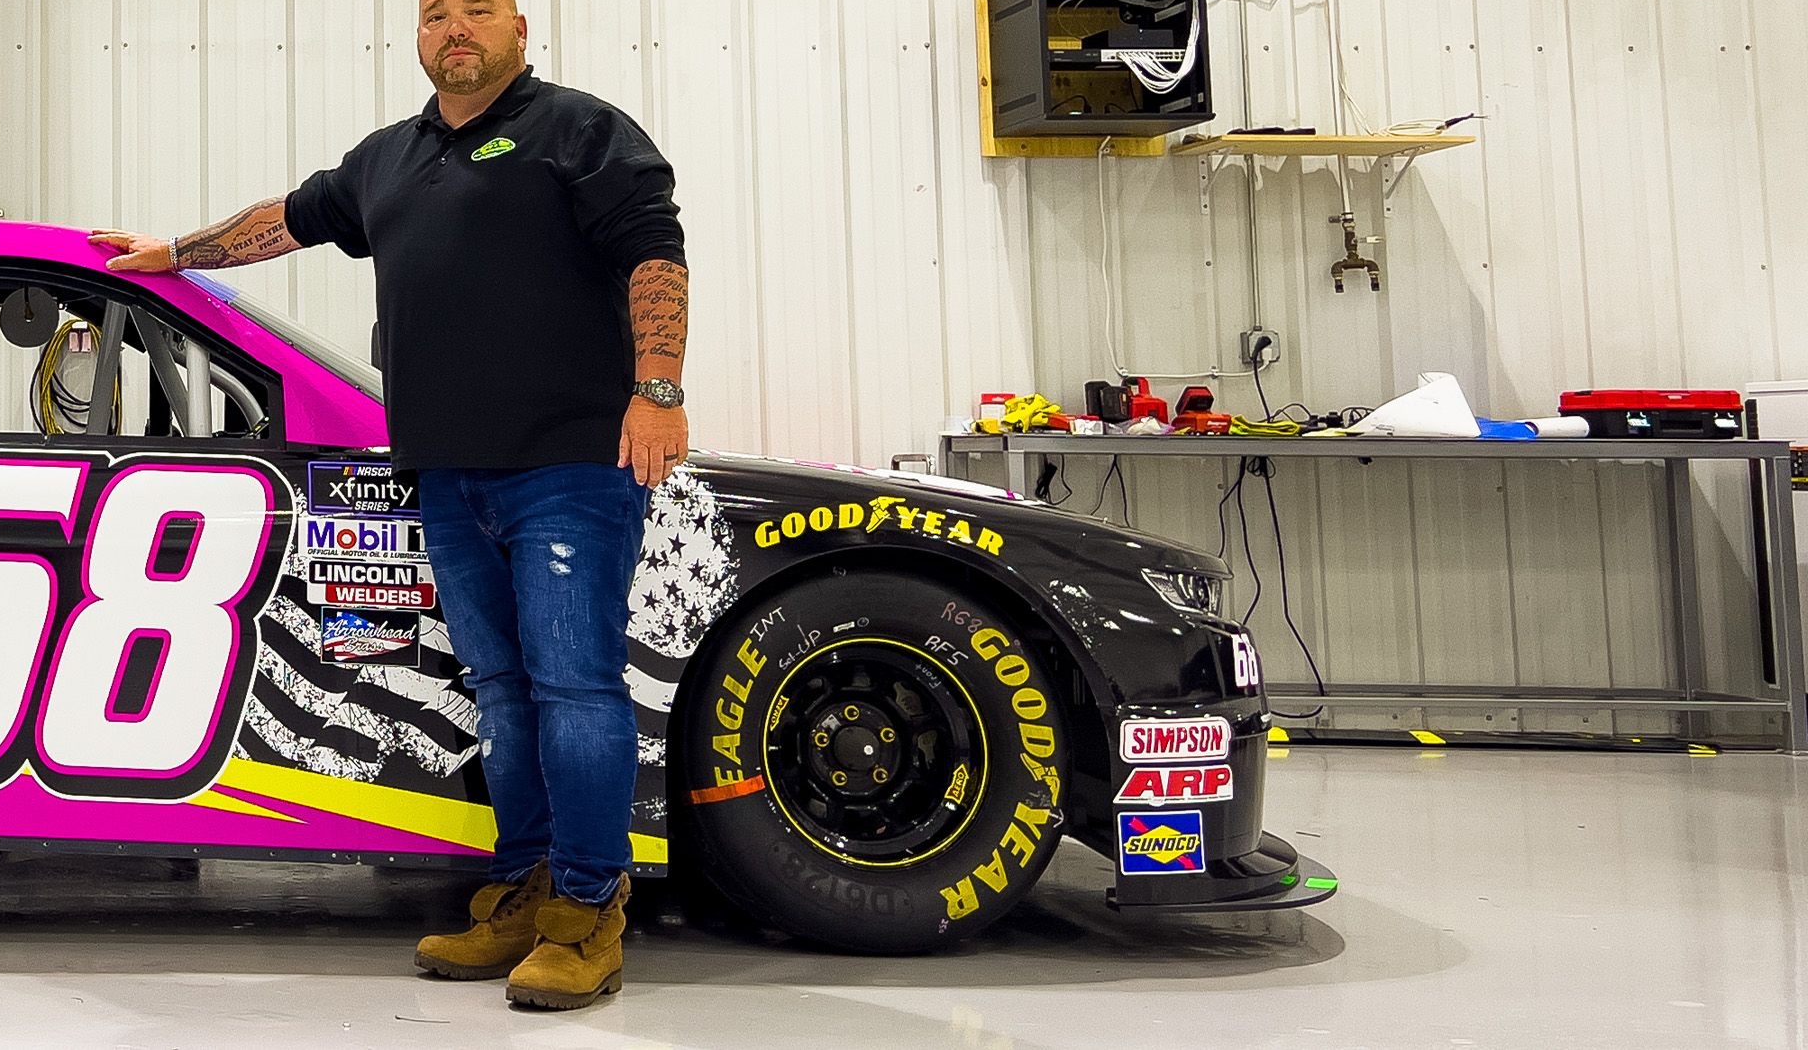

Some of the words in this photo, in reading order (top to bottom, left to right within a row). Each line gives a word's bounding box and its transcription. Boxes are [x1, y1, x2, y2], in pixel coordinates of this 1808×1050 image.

[232, 237, 254, 252] STAY
[356, 466, 392, 478] NASCA
[329, 476, 414, 507] xfinity
[354, 501, 390, 512] SERIES
[306, 521, 397, 552] Mobil
[754, 496, 1005, 556] GOODYEAR
[307, 548, 339, 557] OFFICIAL
[341, 550, 368, 558] MOTOR
[390, 552, 429, 560] LUBRICAN
[313, 563, 413, 585] LINCOLN
[335, 587, 423, 605] WELDERS
[323, 619, 417, 641] Arrowhead
[749, 606, 786, 642] INT
[940, 601, 983, 633] R68
[342, 637, 385, 652] Brass
[1230, 633, 1260, 688] 68
[712, 637, 768, 788] EAGLE
[1131, 725, 1223, 754] SIMPSON
[939, 628, 1058, 920] GOODYEAR
[951, 772, 965, 798] AERO
[1119, 767, 1231, 797] ARP
[1127, 835, 1197, 853] SUNOCO
